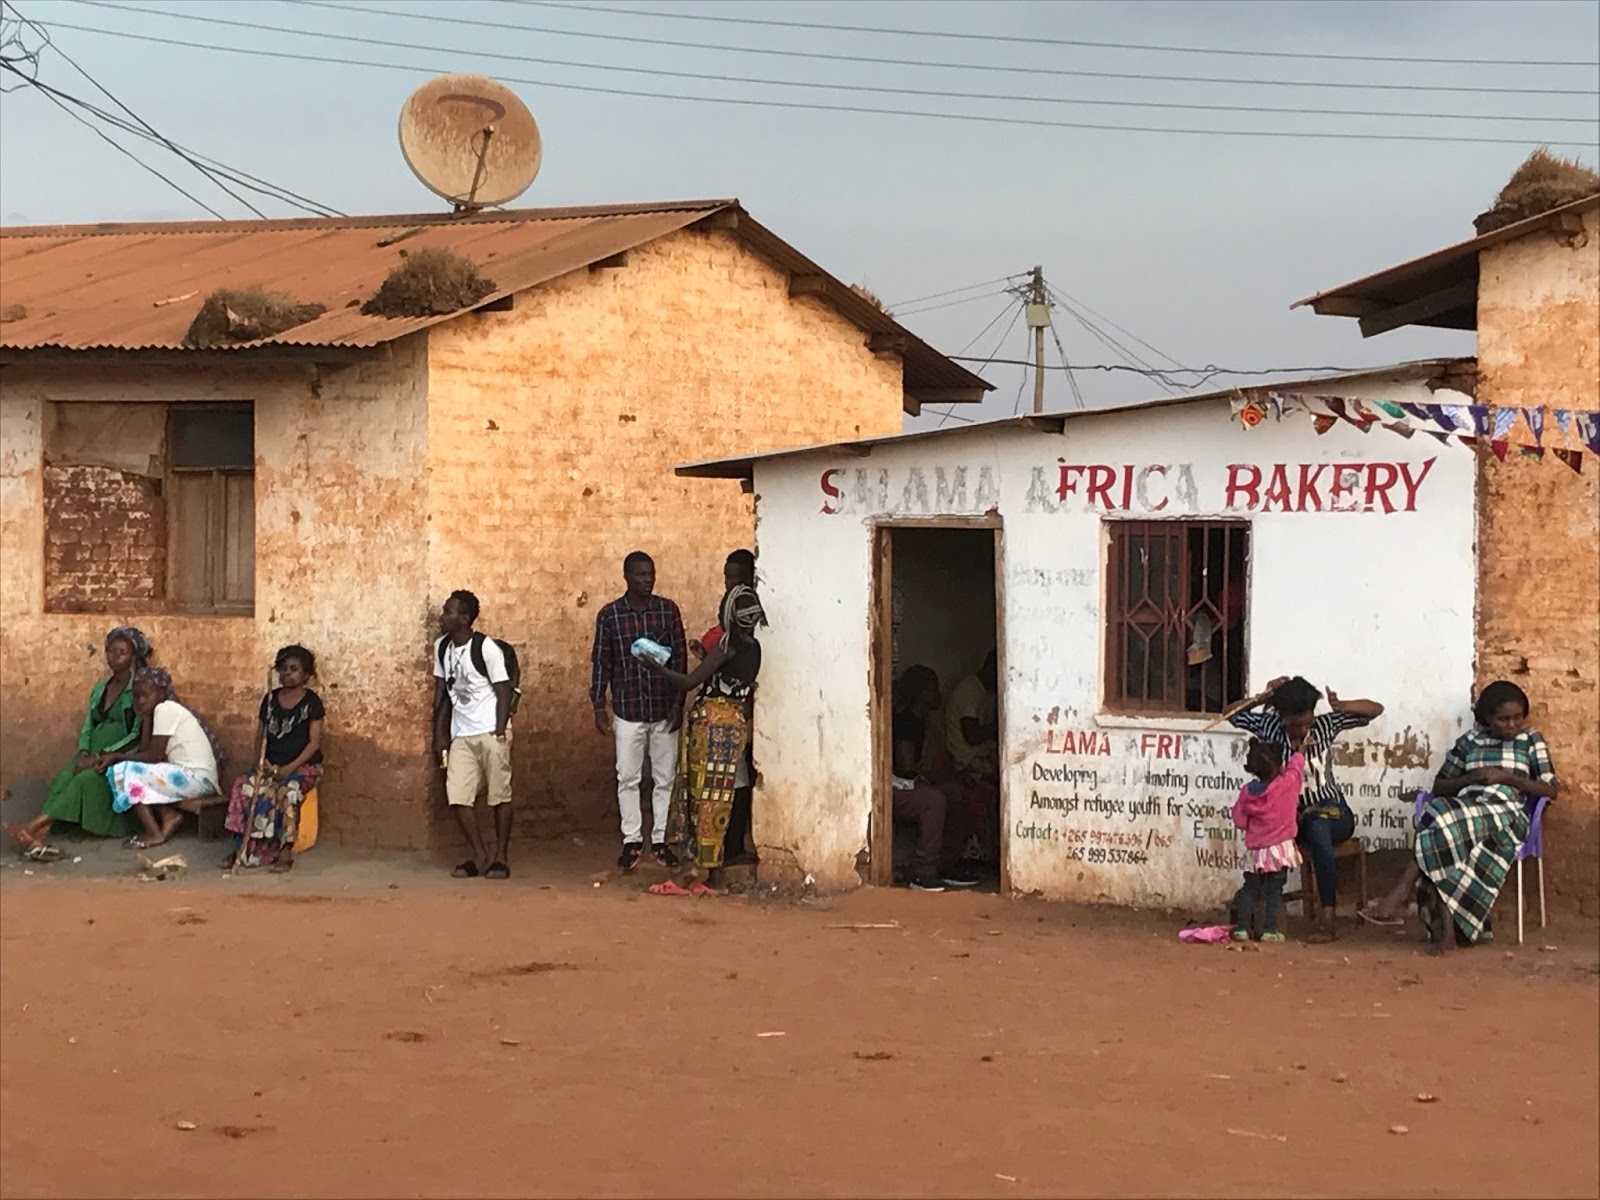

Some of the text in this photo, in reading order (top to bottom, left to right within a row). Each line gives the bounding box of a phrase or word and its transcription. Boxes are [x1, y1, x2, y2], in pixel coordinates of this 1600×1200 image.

[1023, 464, 1199, 513] AFRICA
[1225, 456, 1438, 514] BAKERY
[1032, 761, 1097, 791] Developing
[1195, 771, 1244, 790] creative
[1360, 783, 1381, 798] and
[1030, 790, 1233, 822] Amongst refugee youth for Socio-ec
[1362, 808, 1375, 827] of
[1380, 808, 1408, 829] their
